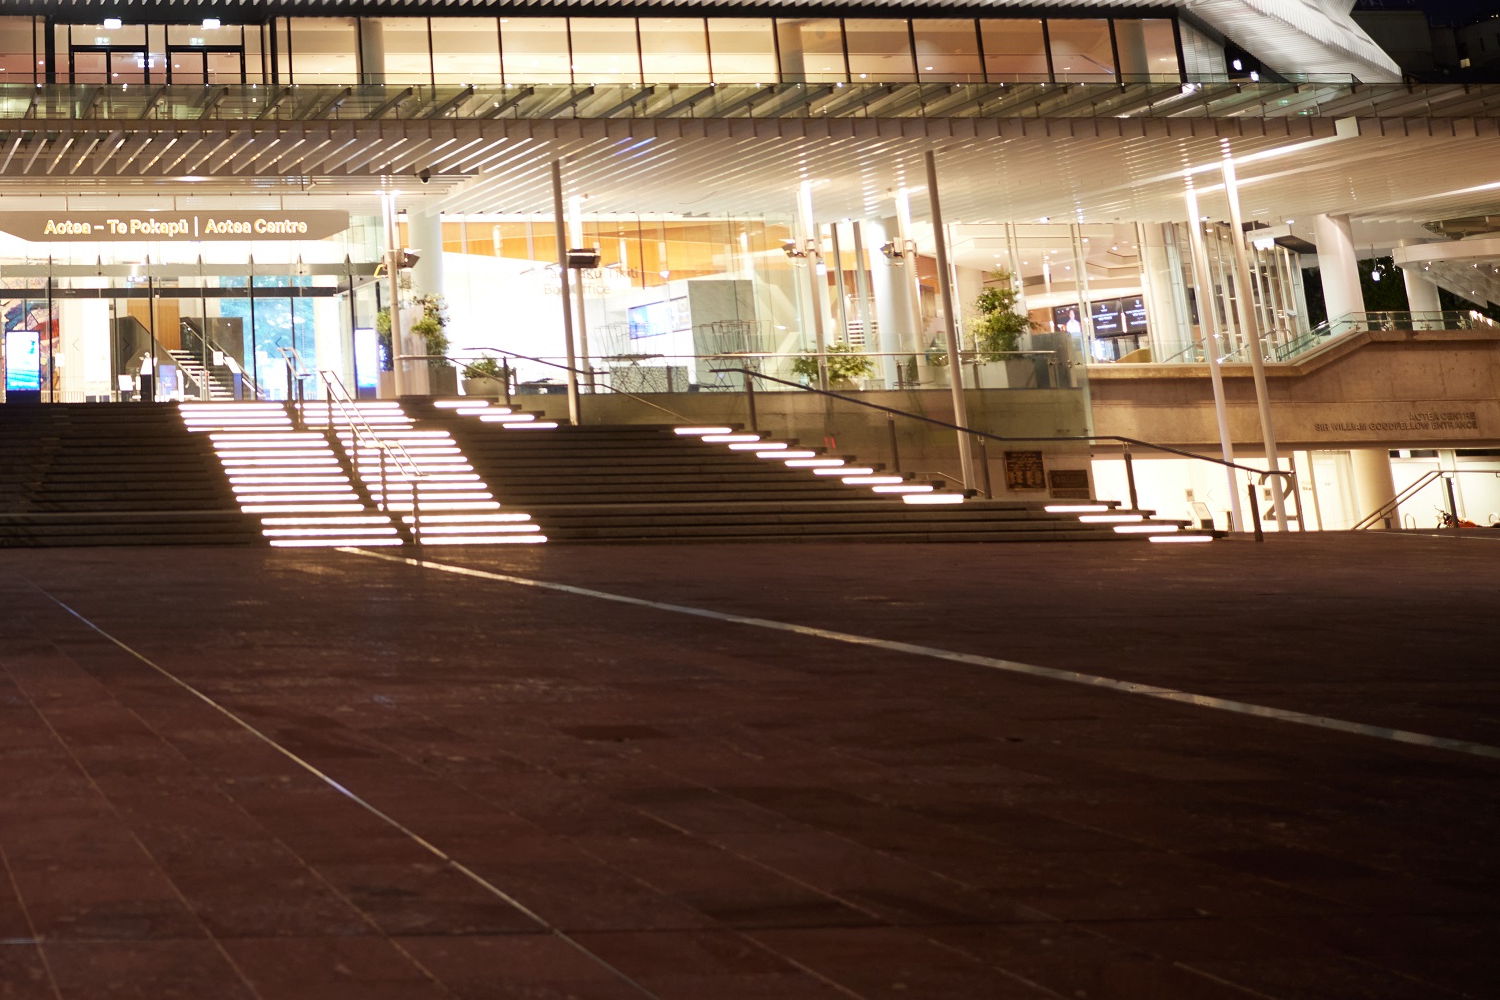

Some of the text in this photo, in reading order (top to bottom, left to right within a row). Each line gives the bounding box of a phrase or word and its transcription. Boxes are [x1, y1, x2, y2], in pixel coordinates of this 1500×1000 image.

[44, 219, 91, 235] Aotea
[106, 219, 128, 235] Te
[130, 217, 189, 238] Pokapū
[204, 218, 251, 234] Aotea
[253, 218, 308, 234] Centre
[1409, 411, 1476, 421] AOTEA CENTRE
[1314, 420, 1478, 432] SIR WILLIAM GOODFELLOW ENTRANCE
[1257, 472, 1299, 521] 2
